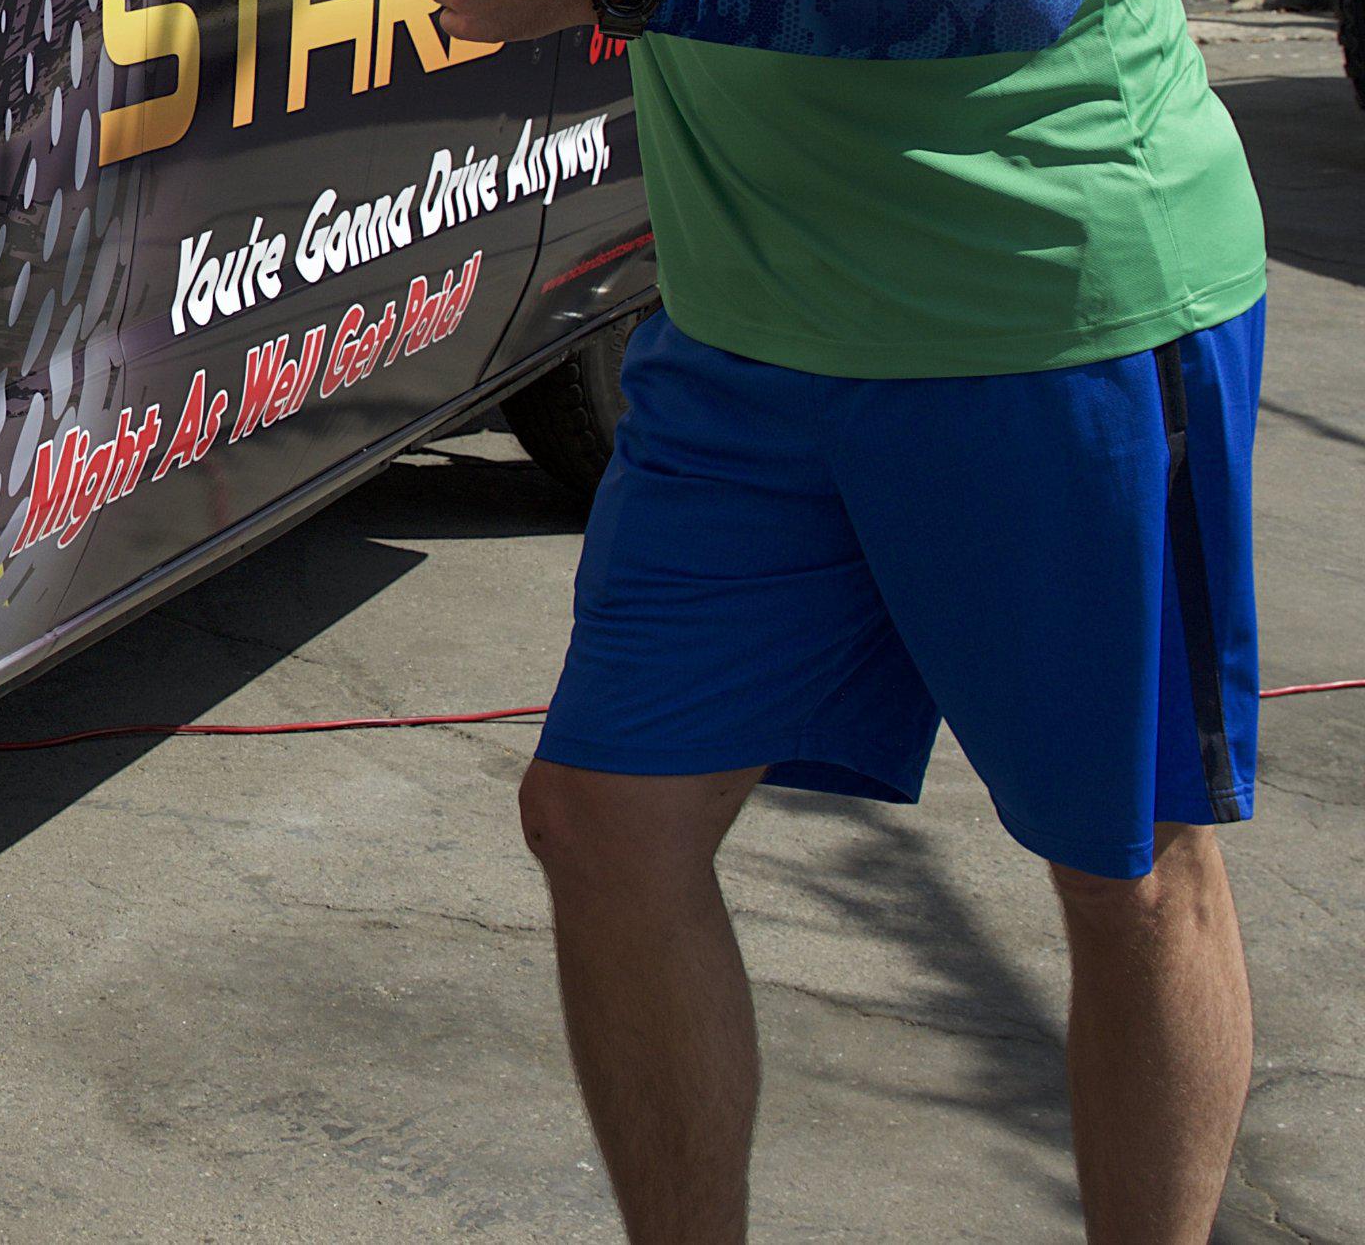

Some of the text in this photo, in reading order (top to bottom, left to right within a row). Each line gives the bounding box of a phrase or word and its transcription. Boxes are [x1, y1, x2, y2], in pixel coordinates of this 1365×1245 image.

[171, 113, 611, 336] You're Gonna Drive Anyway,
[8, 403, 162, 559] Might
[151, 369, 228, 483] As
[229, 324, 328, 445] Well
[319, 301, 397, 400] Get
[384, 250, 484, 369] Paid!
